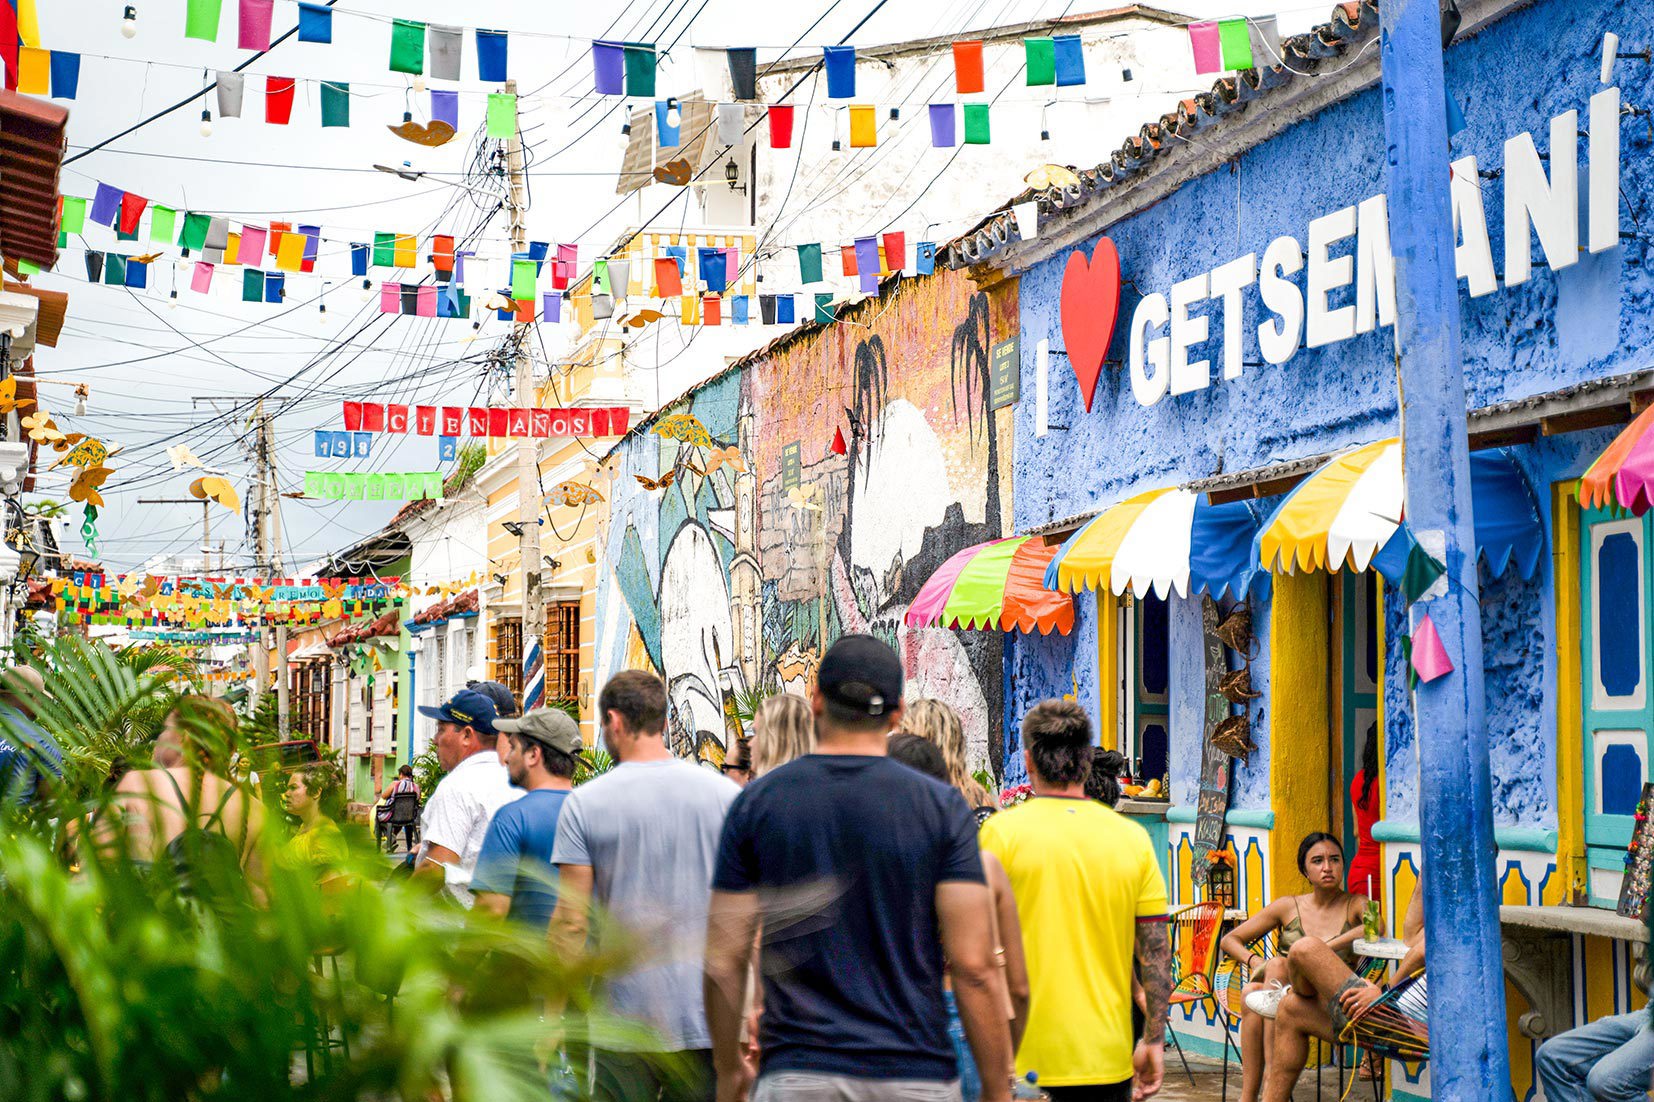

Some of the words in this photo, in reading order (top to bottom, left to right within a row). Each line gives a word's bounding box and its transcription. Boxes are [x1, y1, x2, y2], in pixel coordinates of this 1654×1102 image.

[1035, 338, 1048, 438] I
[390, 414, 486, 433] CIEN
[511, 413, 585, 434] AÑOS
